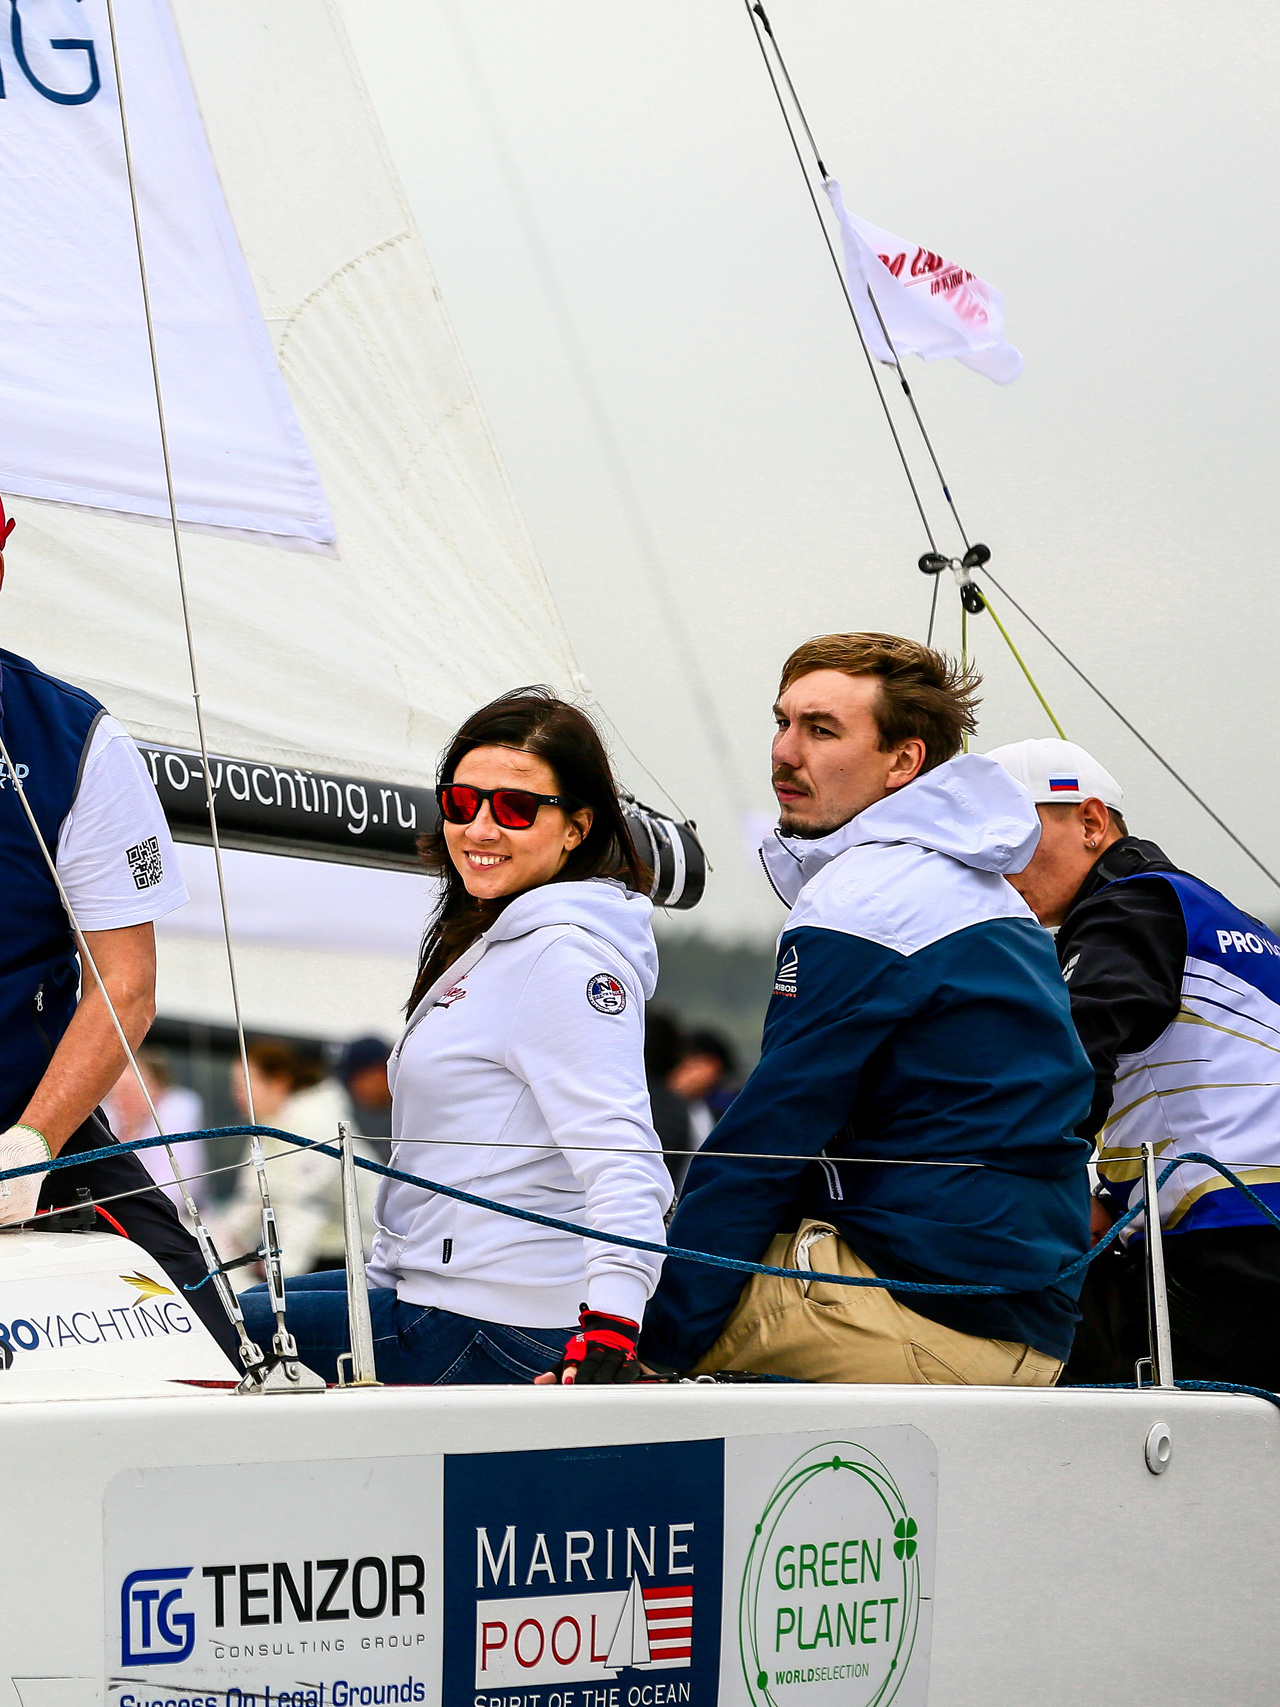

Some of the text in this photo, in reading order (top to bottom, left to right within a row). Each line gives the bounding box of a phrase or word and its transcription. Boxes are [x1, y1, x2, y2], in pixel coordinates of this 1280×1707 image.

[141, 750, 418, 835] ro-yachting.ru
[475, 1521, 695, 1589] MARINE
[775, 1537, 882, 1591] GREEN
[202, 1554, 426, 1629] TENZOR
[214, 1633, 427, 1660] CONSULTING GROUP
[480, 1613, 609, 1672] POOL
[775, 1597, 899, 1653] PLANET
[332, 1675, 426, 1707] Grounds
[548, 1691, 575, 1707] OF
[582, 1688, 621, 1707] THE
[627, 1681, 691, 1707] OCEAN
[775, 1662, 870, 1686] WORLDSELECTION
